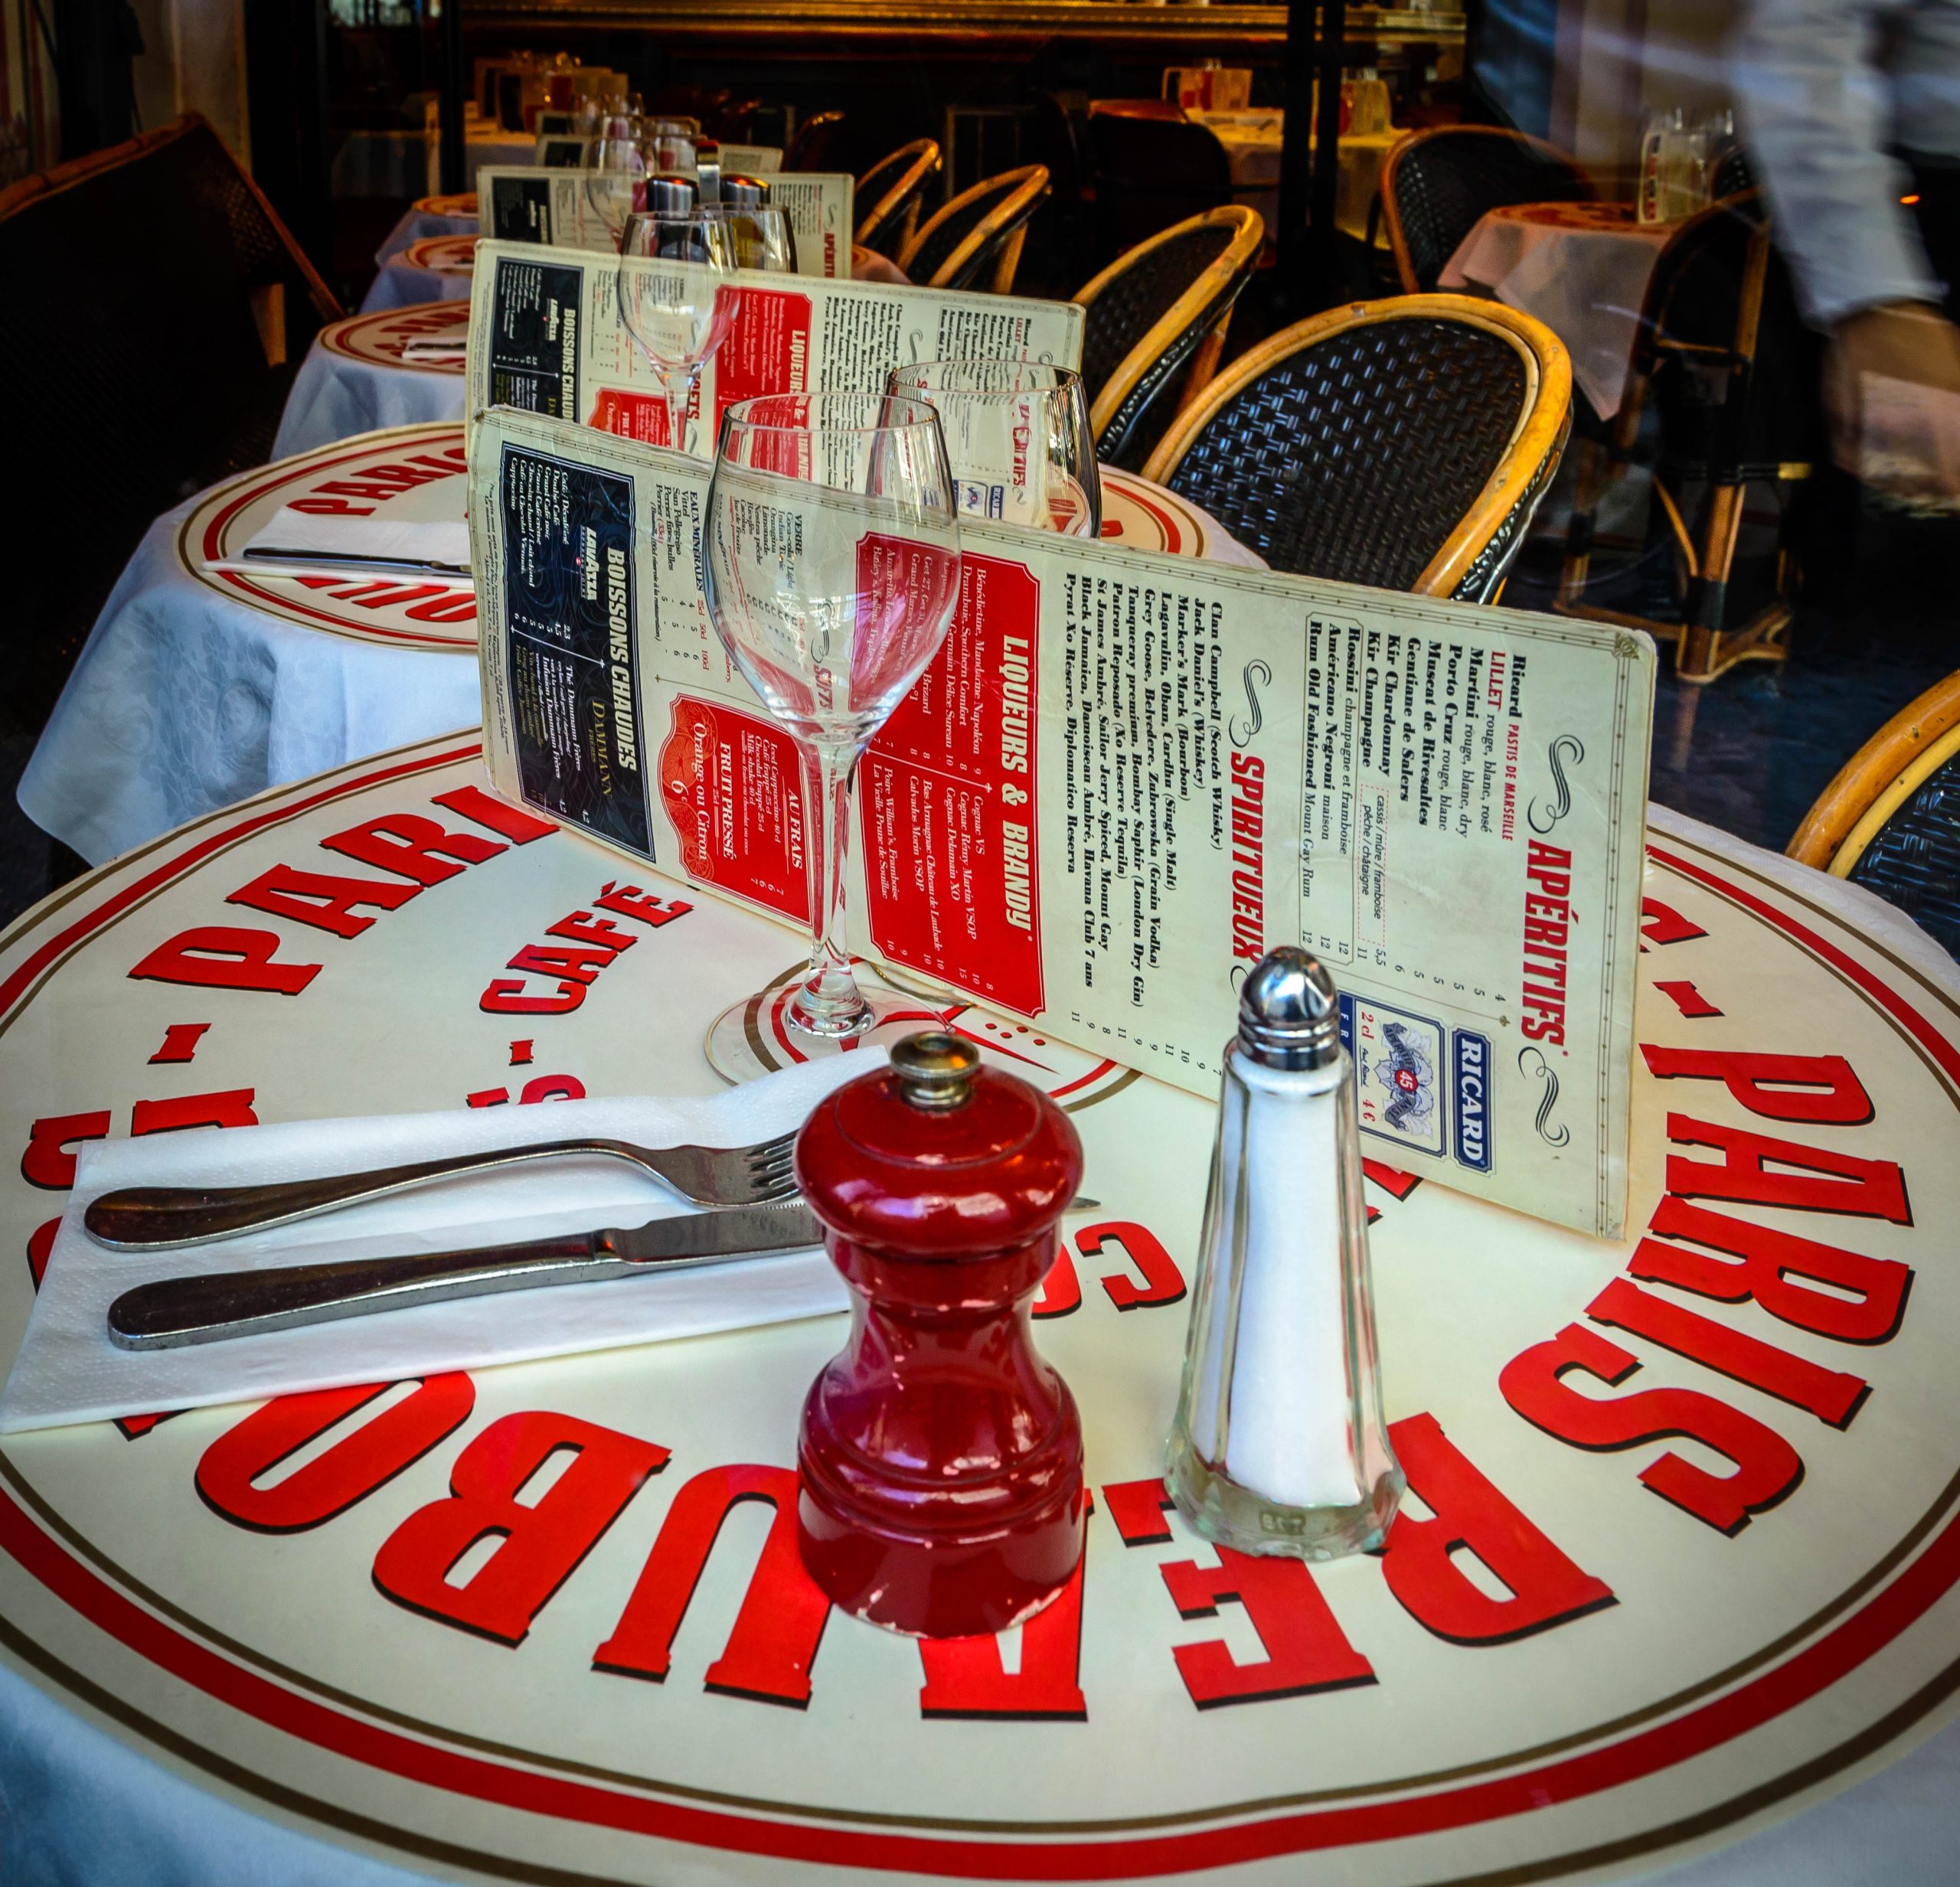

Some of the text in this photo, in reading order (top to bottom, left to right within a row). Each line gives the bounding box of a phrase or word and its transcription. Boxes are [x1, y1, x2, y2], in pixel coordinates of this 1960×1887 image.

[561, 308, 576, 422] BOISSONS CHAUD
[681, 490, 690, 517] Vittel
[689, 491, 701, 524] EAUX
[762, 504, 770, 556] Limonade
[794, 514, 804, 556] VERRE
[586, 527, 599, 600] LAVAZZA
[697, 599, 705, 616] 25cl
[1081, 575, 1092, 620] Black
[1112, 581, 1122, 637] Patron
[607, 547, 637, 772] BOISSONS CHAUDES
[701, 649, 709, 671] 100cl
[959, 680, 969, 726] Comfort
[960, 625, 970, 677] Southern
[998, 634, 1028, 773] LIQUEURS
[1080, 625, 1092, 694] Jamaica,
[1109, 642, 1123, 718] Reposado
[1176, 594, 1190, 801] Marker's Mark (Bourbon)
[1192, 597, 1205, 788] Jack Daniel's (Whiskey)
[1360, 630, 1380, 767] Kir Champagne
[1377, 633, 1401, 776] Kir Chardonnay
[565, 664, 581, 771] Thé Dammann Frères
[970, 700, 983, 754] Napoléon
[1081, 699, 1093, 783] Damoiseau
[1158, 591, 1176, 890] Lagavulin, Oban, Cardhu (Single Malt)
[1207, 602, 1223, 850] Clan Campbell (Scotch Whisky)
[1302, 621, 1322, 896] Rum Old Fashioned Mount Gay Rum
[1321, 622, 1341, 839] Américano Negroni maison
[1340, 627, 1361, 854] Rossini champagne et framboise
[1400, 637, 1421, 801] Gentiane de Salers
[1418, 639, 1442, 825] Muscat de Rivesaltes
[1437, 643, 1462, 831] Porto Cruz rouge, blanc
[1455, 646, 1484, 834] Martini rouge, blanc, dry
[1480, 651, 1505, 833] LILLET rouge, blanc, rosé
[1501, 654, 1527, 841] Ricard PASTIS DE MARSEILLE
[691, 722, 710, 860] Orange ou Citron
[720, 742, 737, 860] FRUIT PRESSÉ
[789, 788, 802, 870] AU FRAIS
[1001, 782, 1027, 805] &
[1083, 787, 1094, 843] Ambré,
[1116, 753, 1126, 812] Reserve
[1125, 585, 1144, 1007] Tanqueray premium, Bombay Saphir (London Dry Gin)
[1143, 589, 1161, 968] Grey Goose, Belvedere, Zubrowska (Grain Vodka)
[128, 785, 560, 995] PARI
[922, 779, 942, 951] Bas Armagnac Château de Laubade
[957, 791, 976, 939] Cognac Rémy Martin VSOP
[1083, 847, 1095, 904] Havana
[1114, 818, 1128, 879] Tequila)
[1230, 752, 1265, 962] SPIRITUEUX
[479, 880, 694, 1015] CAFÉ
[1084, 909, 1095, 943] Club
[1084, 949, 1095, 958] 7
[1361, 1011, 1374, 1039] 2 cl
[1400, 1070, 1413, 1088] 45
[1362, 1099, 1376, 1121] 4 €
[1461, 1038, 1483, 1162] RICARD
[1498, 1043, 1916, 1537] PARIS
